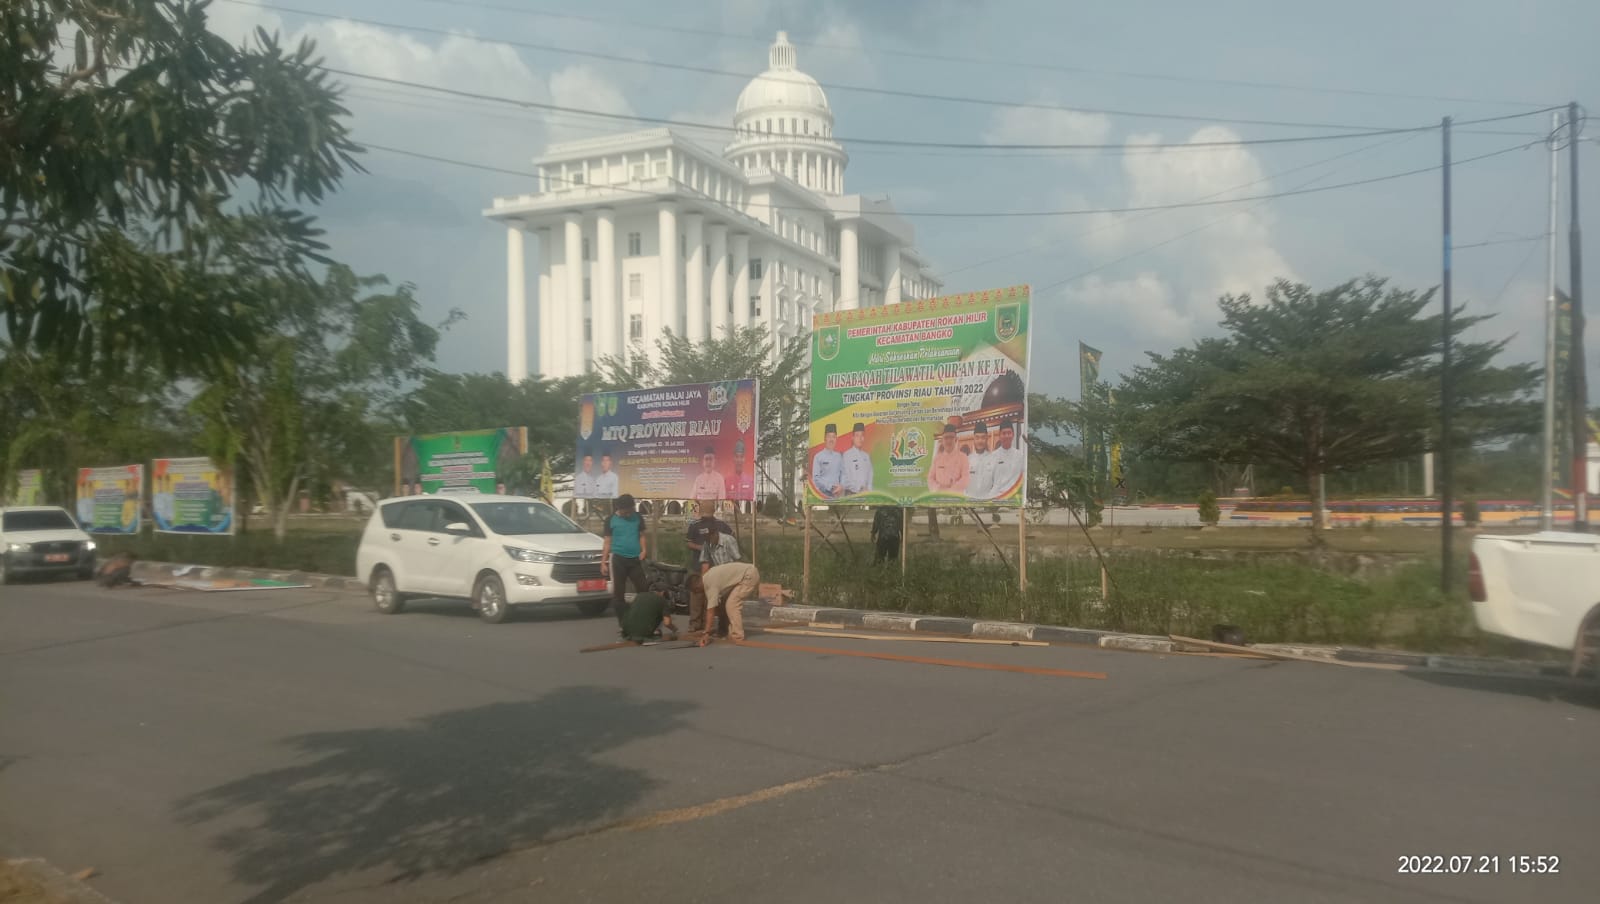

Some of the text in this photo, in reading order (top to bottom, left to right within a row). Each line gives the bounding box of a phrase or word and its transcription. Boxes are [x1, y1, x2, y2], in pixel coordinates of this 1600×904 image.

[847, 312, 987, 337] PEMERINTAH KABUPATEN ROKAN HILIR
[877, 329, 953, 346] KECAMATAN BANGKO
[827, 370, 882, 389] MUSABAQAH
[884, 365, 935, 383] TILAWATIL
[937, 361, 974, 382] QUR'AN
[977, 360, 991, 375] KE
[627, 390, 701, 404] KECAMATAN BALAI JAYA
[843, 383, 984, 403] TINGKAT PROVINSI RIAU TAHUN 2022
[602, 419, 721, 442] MTQ PROVINSI RIAU
